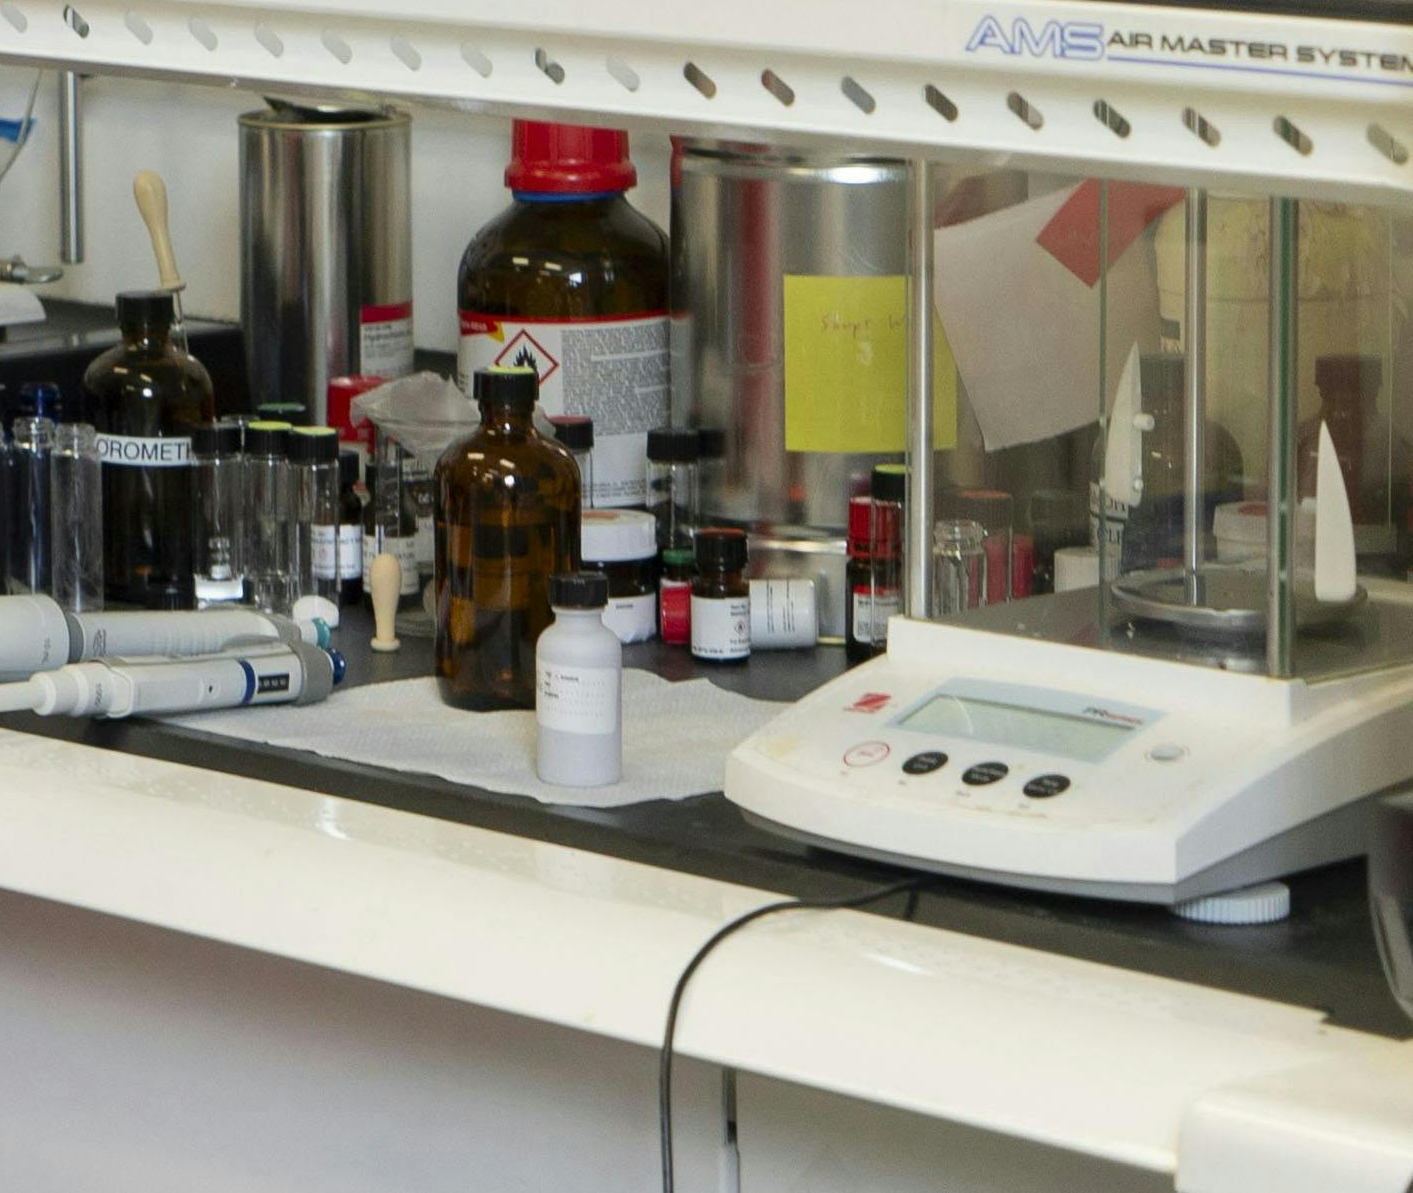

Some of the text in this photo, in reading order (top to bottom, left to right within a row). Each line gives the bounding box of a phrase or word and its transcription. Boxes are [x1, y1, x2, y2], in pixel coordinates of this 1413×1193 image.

[966, 15, 1105, 61] AMS
[1107, 30, 1153, 49] AIR
[1161, 34, 1288, 61] MASTER
